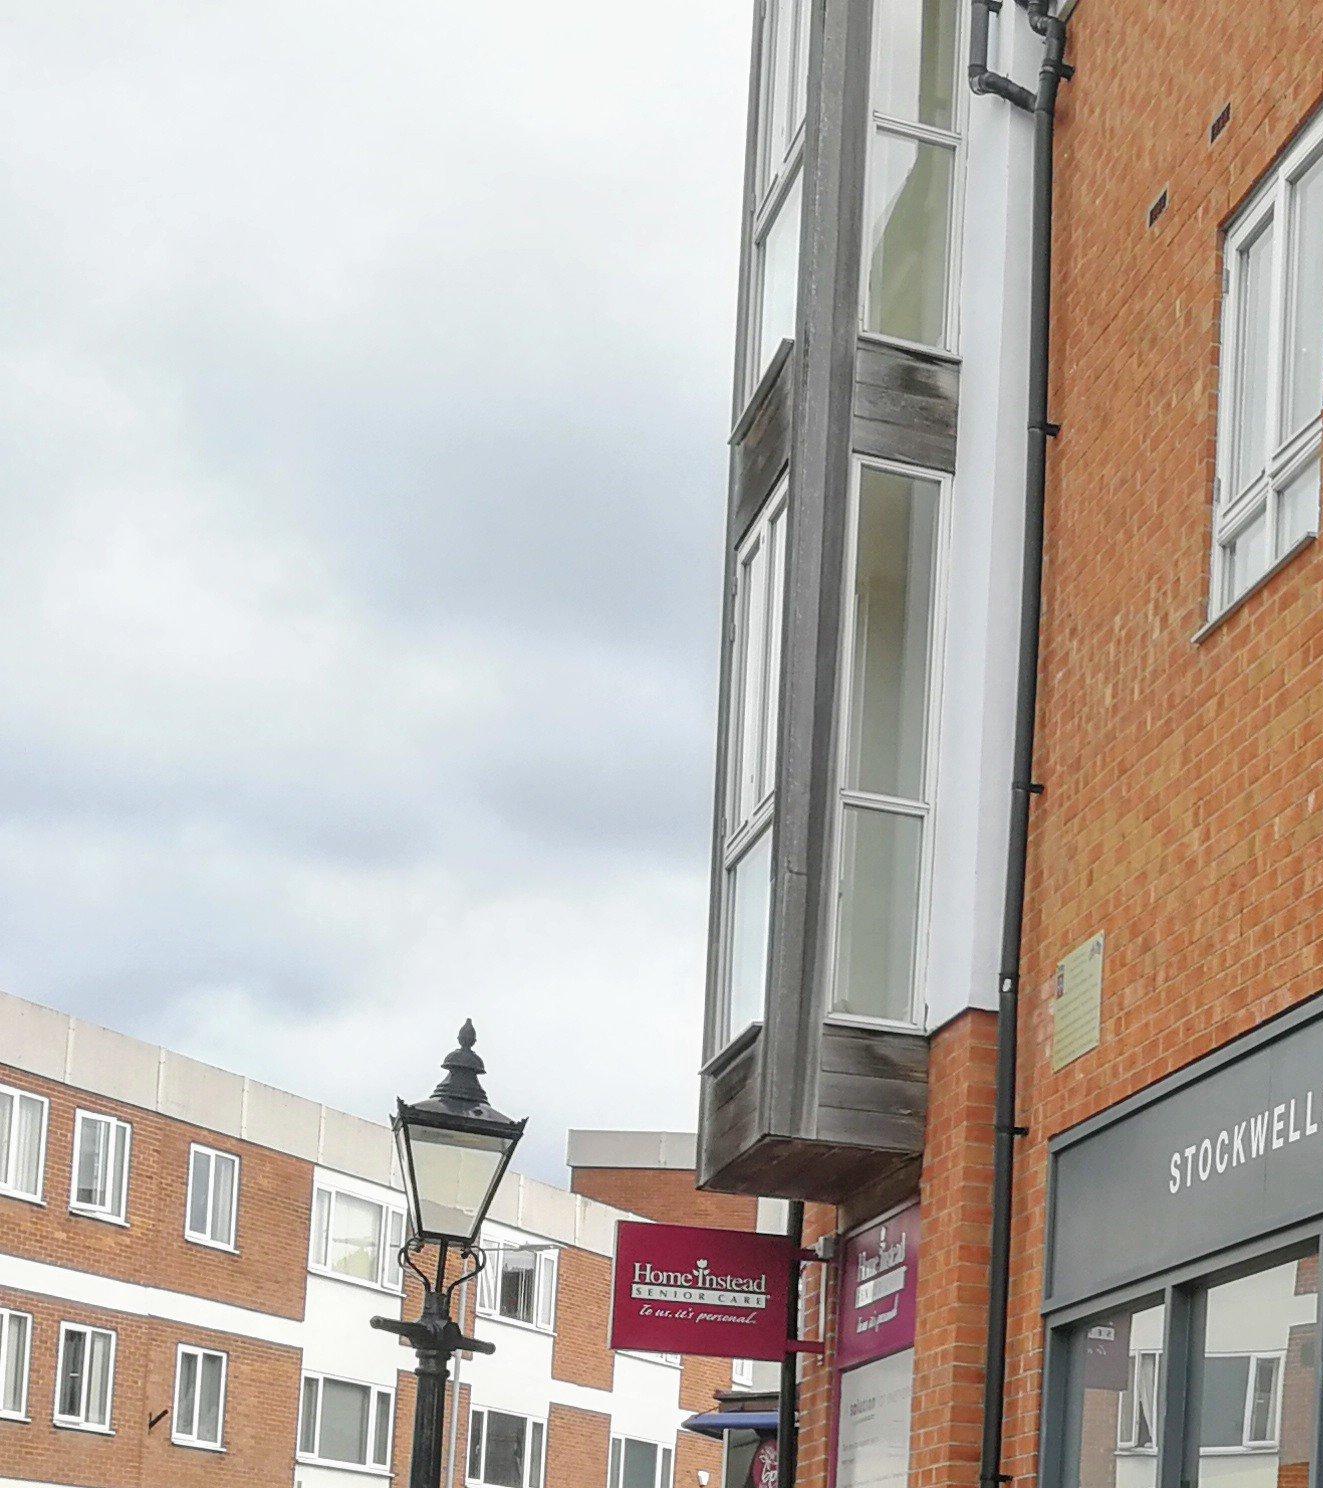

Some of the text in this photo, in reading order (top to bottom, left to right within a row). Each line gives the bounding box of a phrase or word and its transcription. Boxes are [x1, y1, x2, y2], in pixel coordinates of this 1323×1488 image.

[634, 1262, 766, 1293] Home Instead
[635, 1287, 763, 1306] SENIOR CARE
